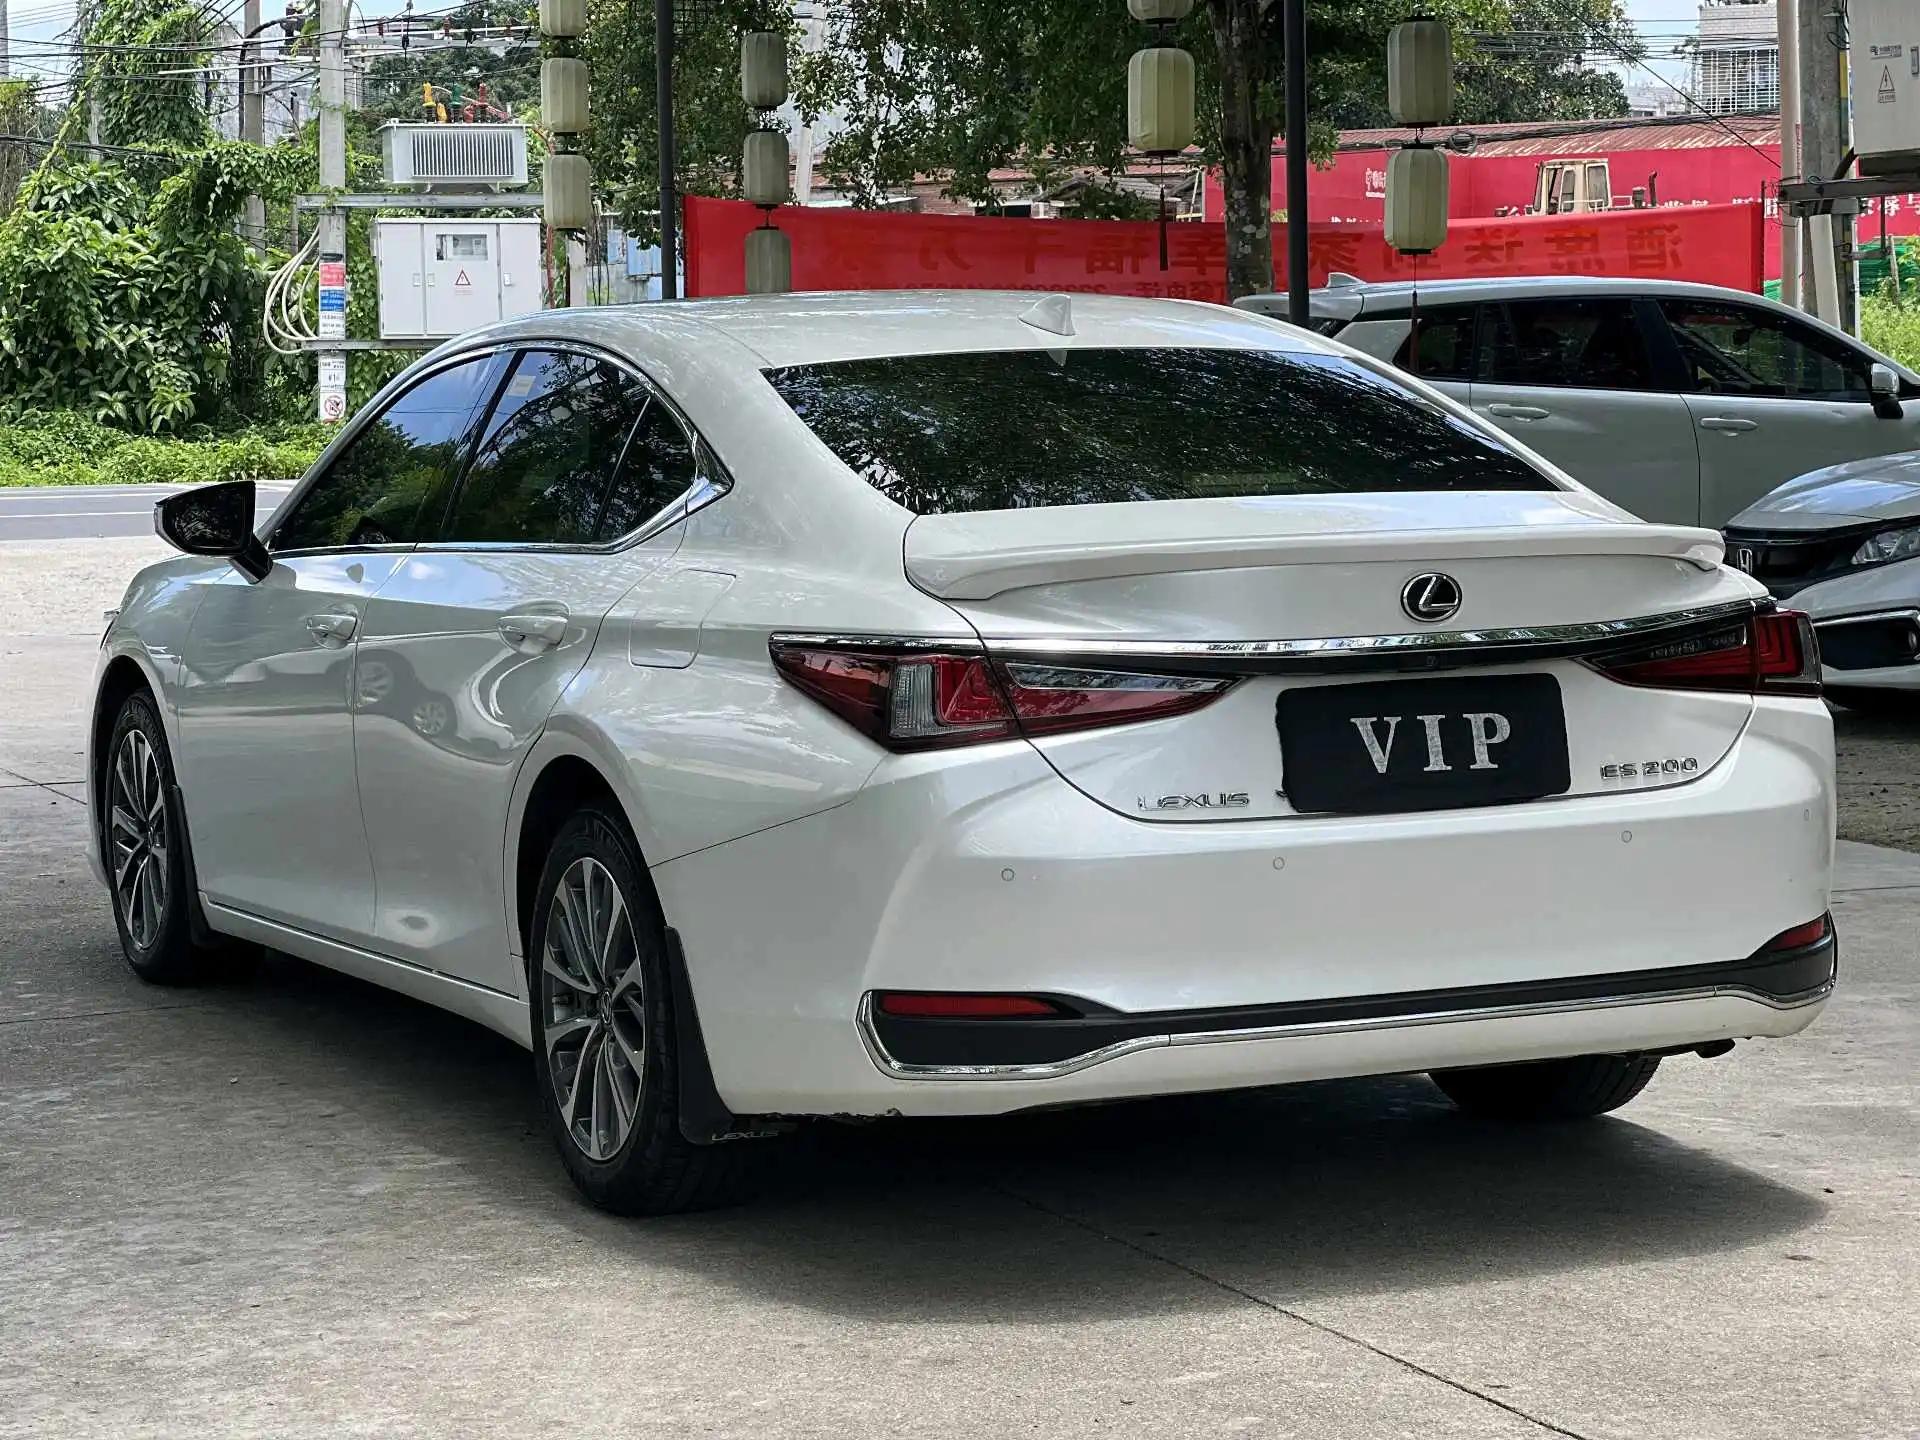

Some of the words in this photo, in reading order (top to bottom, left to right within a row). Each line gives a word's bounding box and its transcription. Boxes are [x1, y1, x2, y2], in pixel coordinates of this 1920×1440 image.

[1349, 712, 1511, 774] VIP
[1600, 763, 1639, 780] ES
[1641, 757, 1698, 776] 200
[1137, 792, 1250, 811] LEXUS
